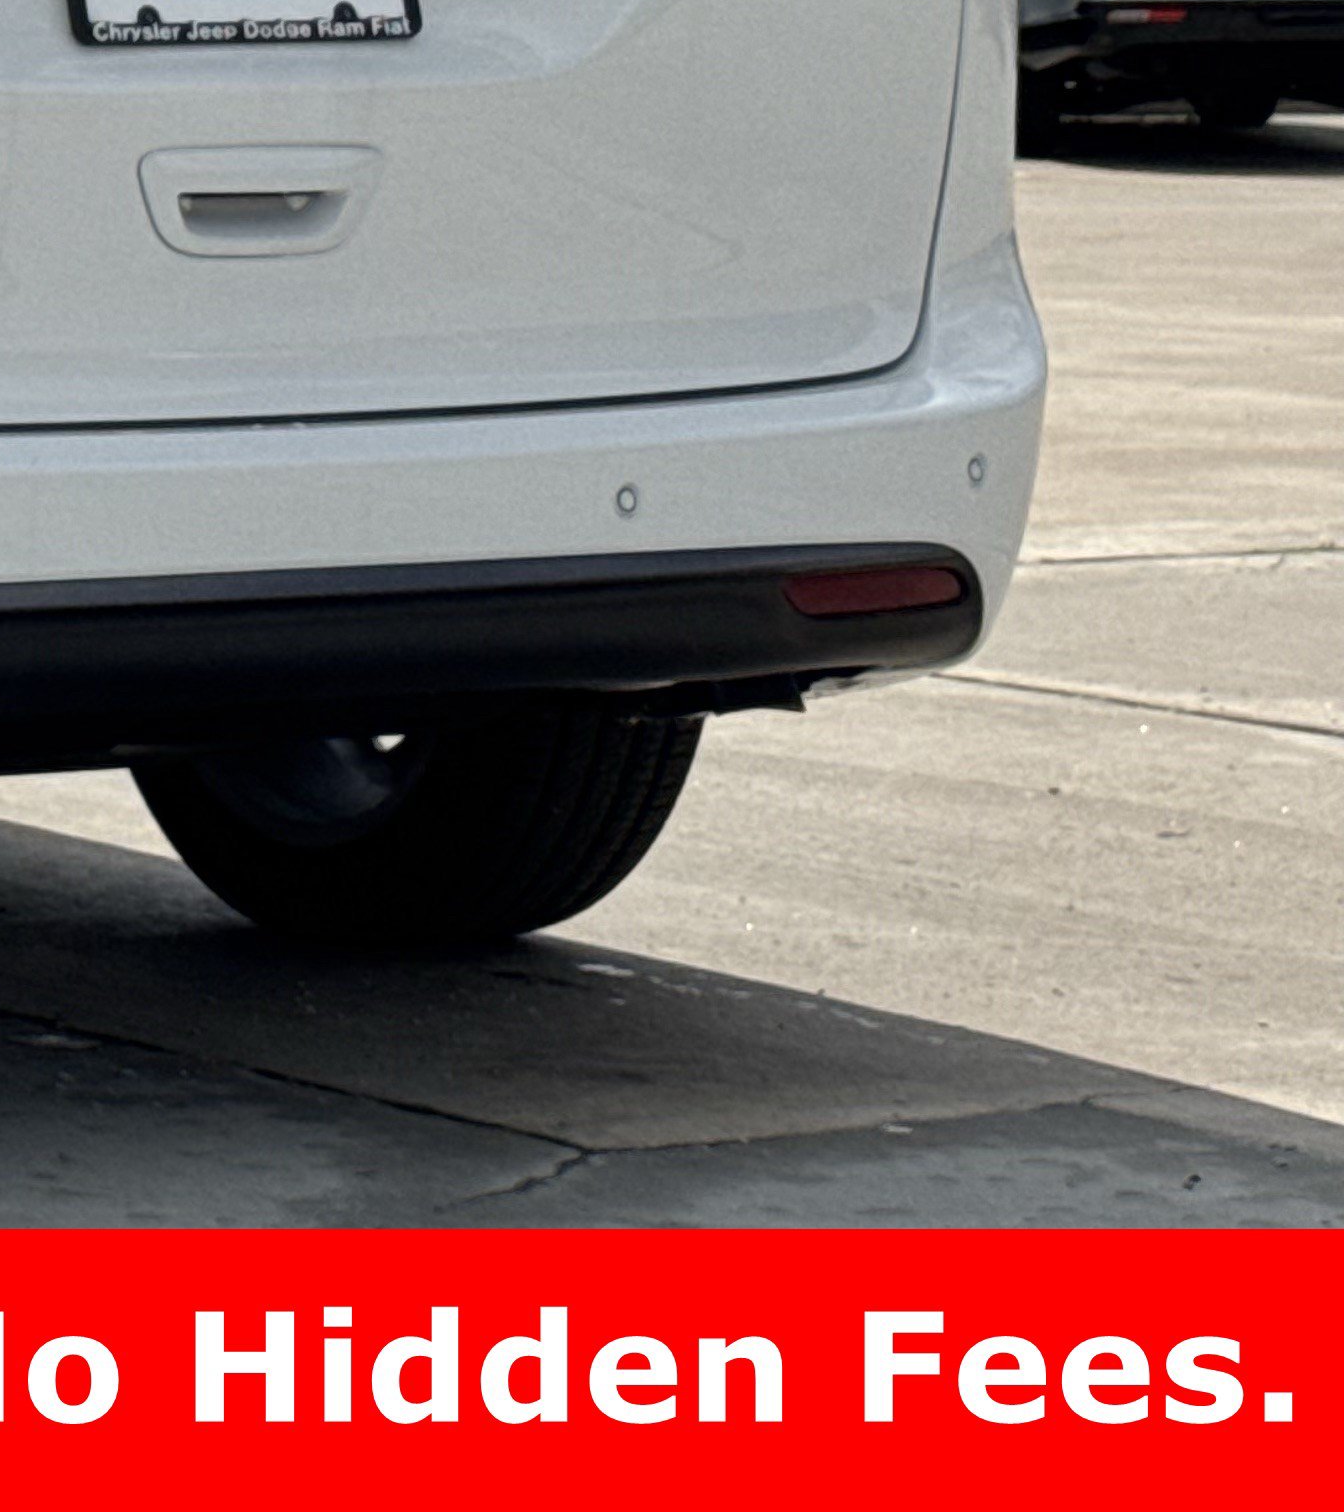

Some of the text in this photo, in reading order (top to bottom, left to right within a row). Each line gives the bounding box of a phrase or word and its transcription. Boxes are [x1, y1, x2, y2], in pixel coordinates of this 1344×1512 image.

[92, 16, 411, 42] Chrysler Jeep Dodge Ram Fiat
